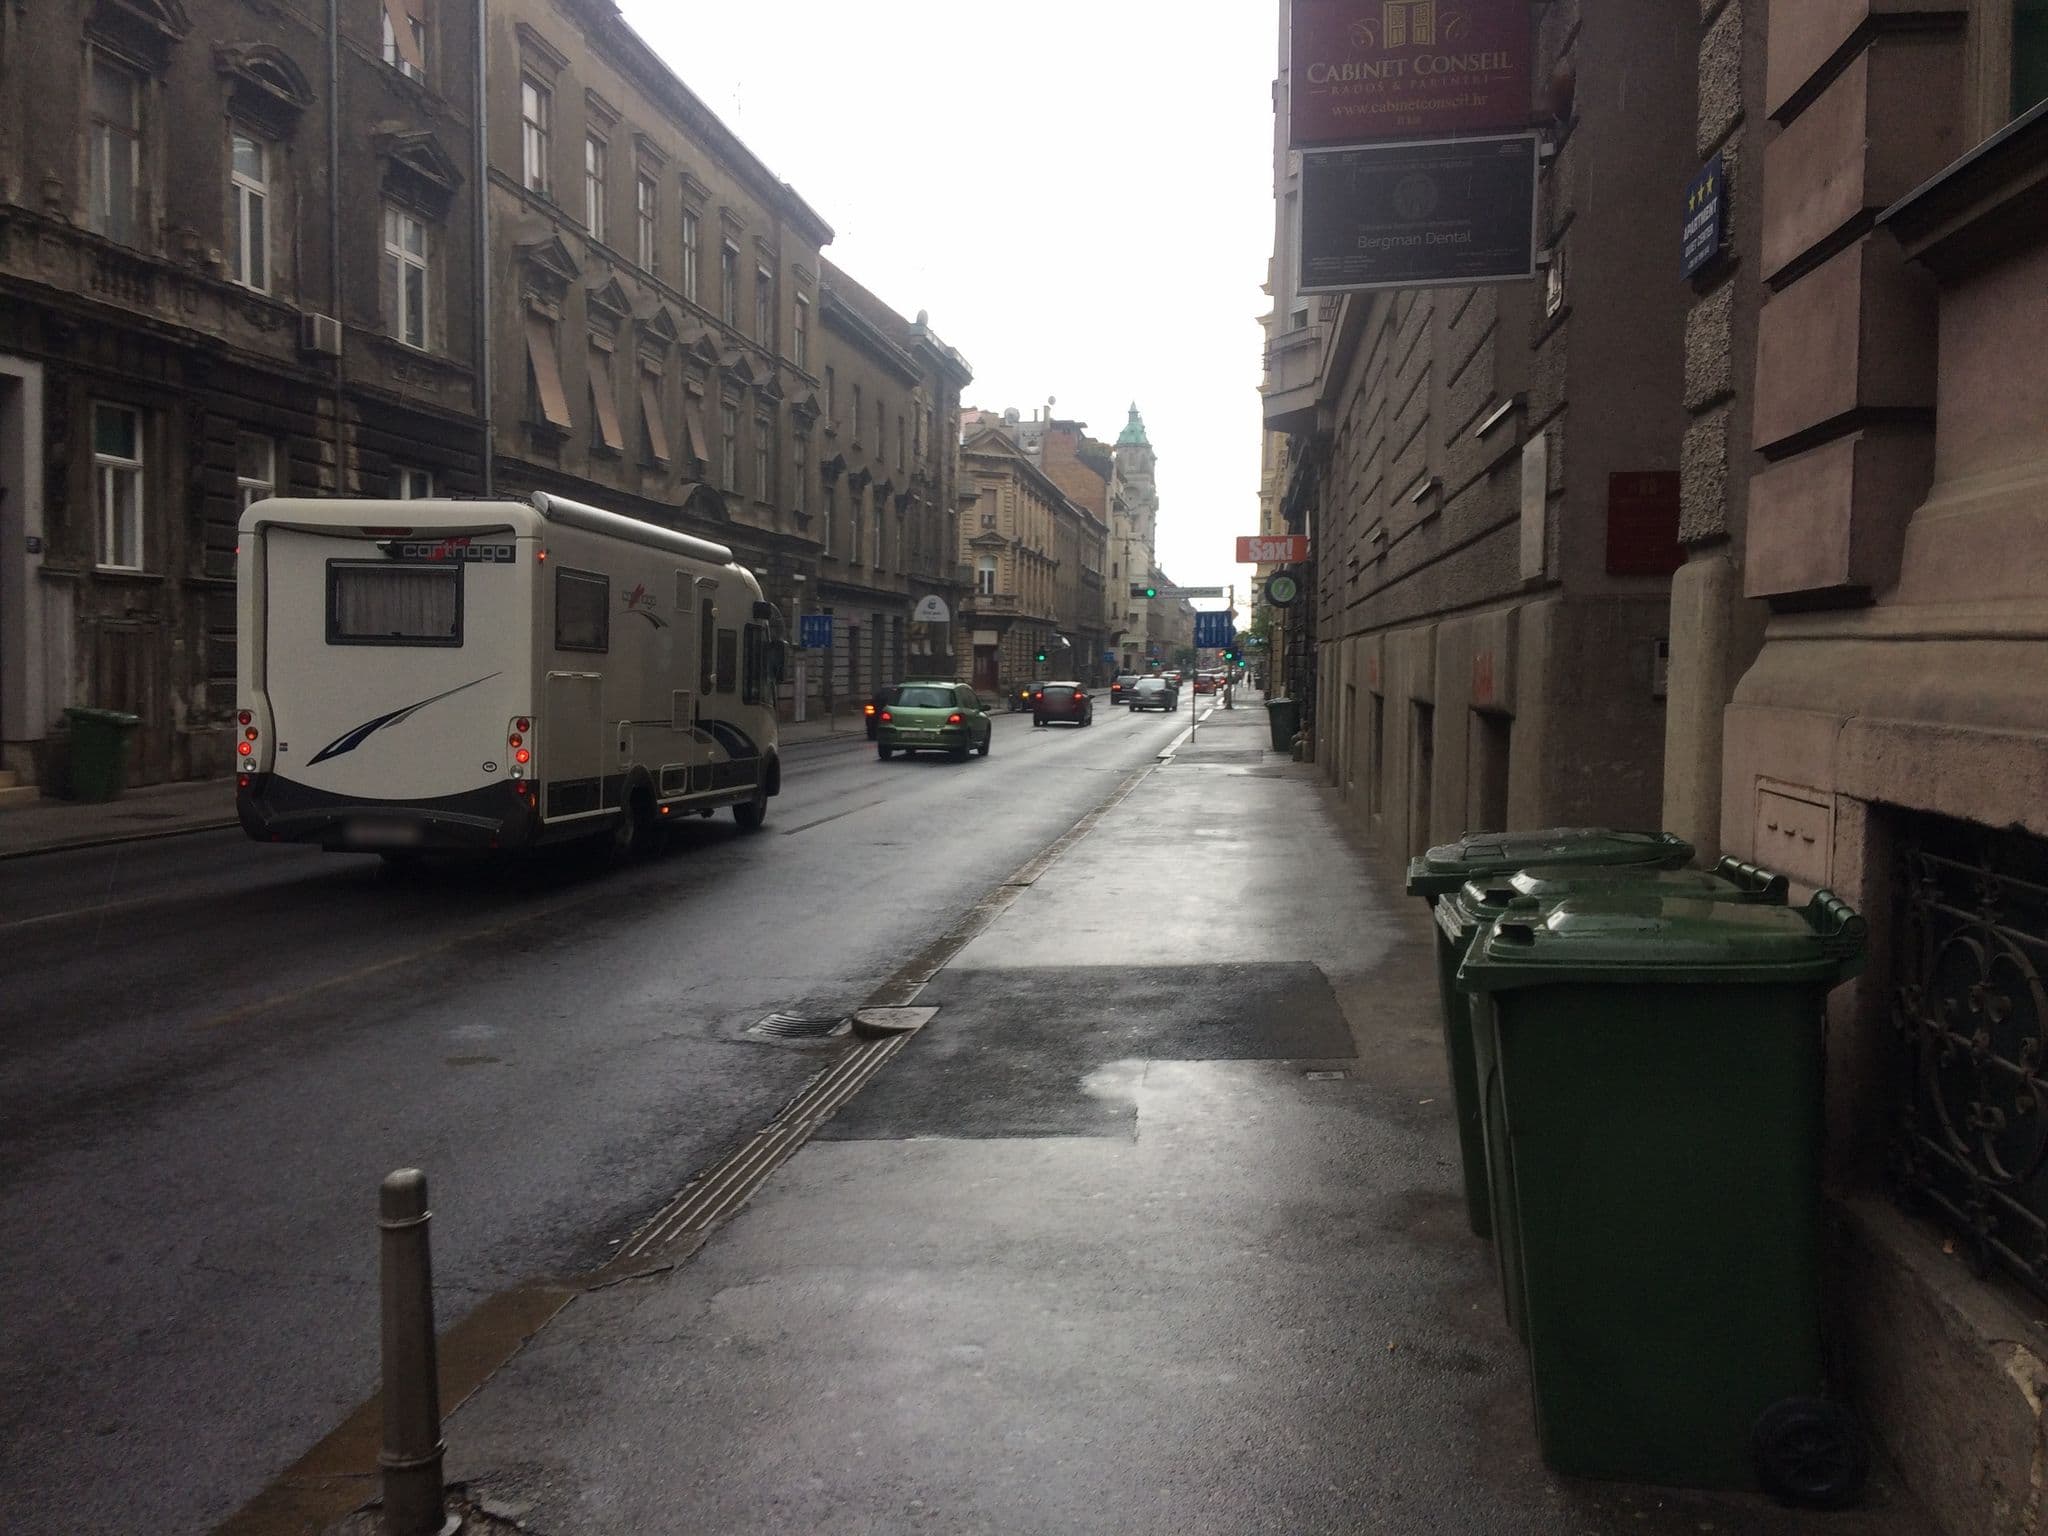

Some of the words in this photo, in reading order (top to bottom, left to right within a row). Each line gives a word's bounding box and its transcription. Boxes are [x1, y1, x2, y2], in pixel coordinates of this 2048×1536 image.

[1307, 58, 1408, 84] CABINET
[1414, 51, 1514, 76] CONSEIL
[1358, 234, 1421, 250] Bergman
[1425, 229, 1472, 245] Dental
[1248, 538, 1294, 560] Sax!
